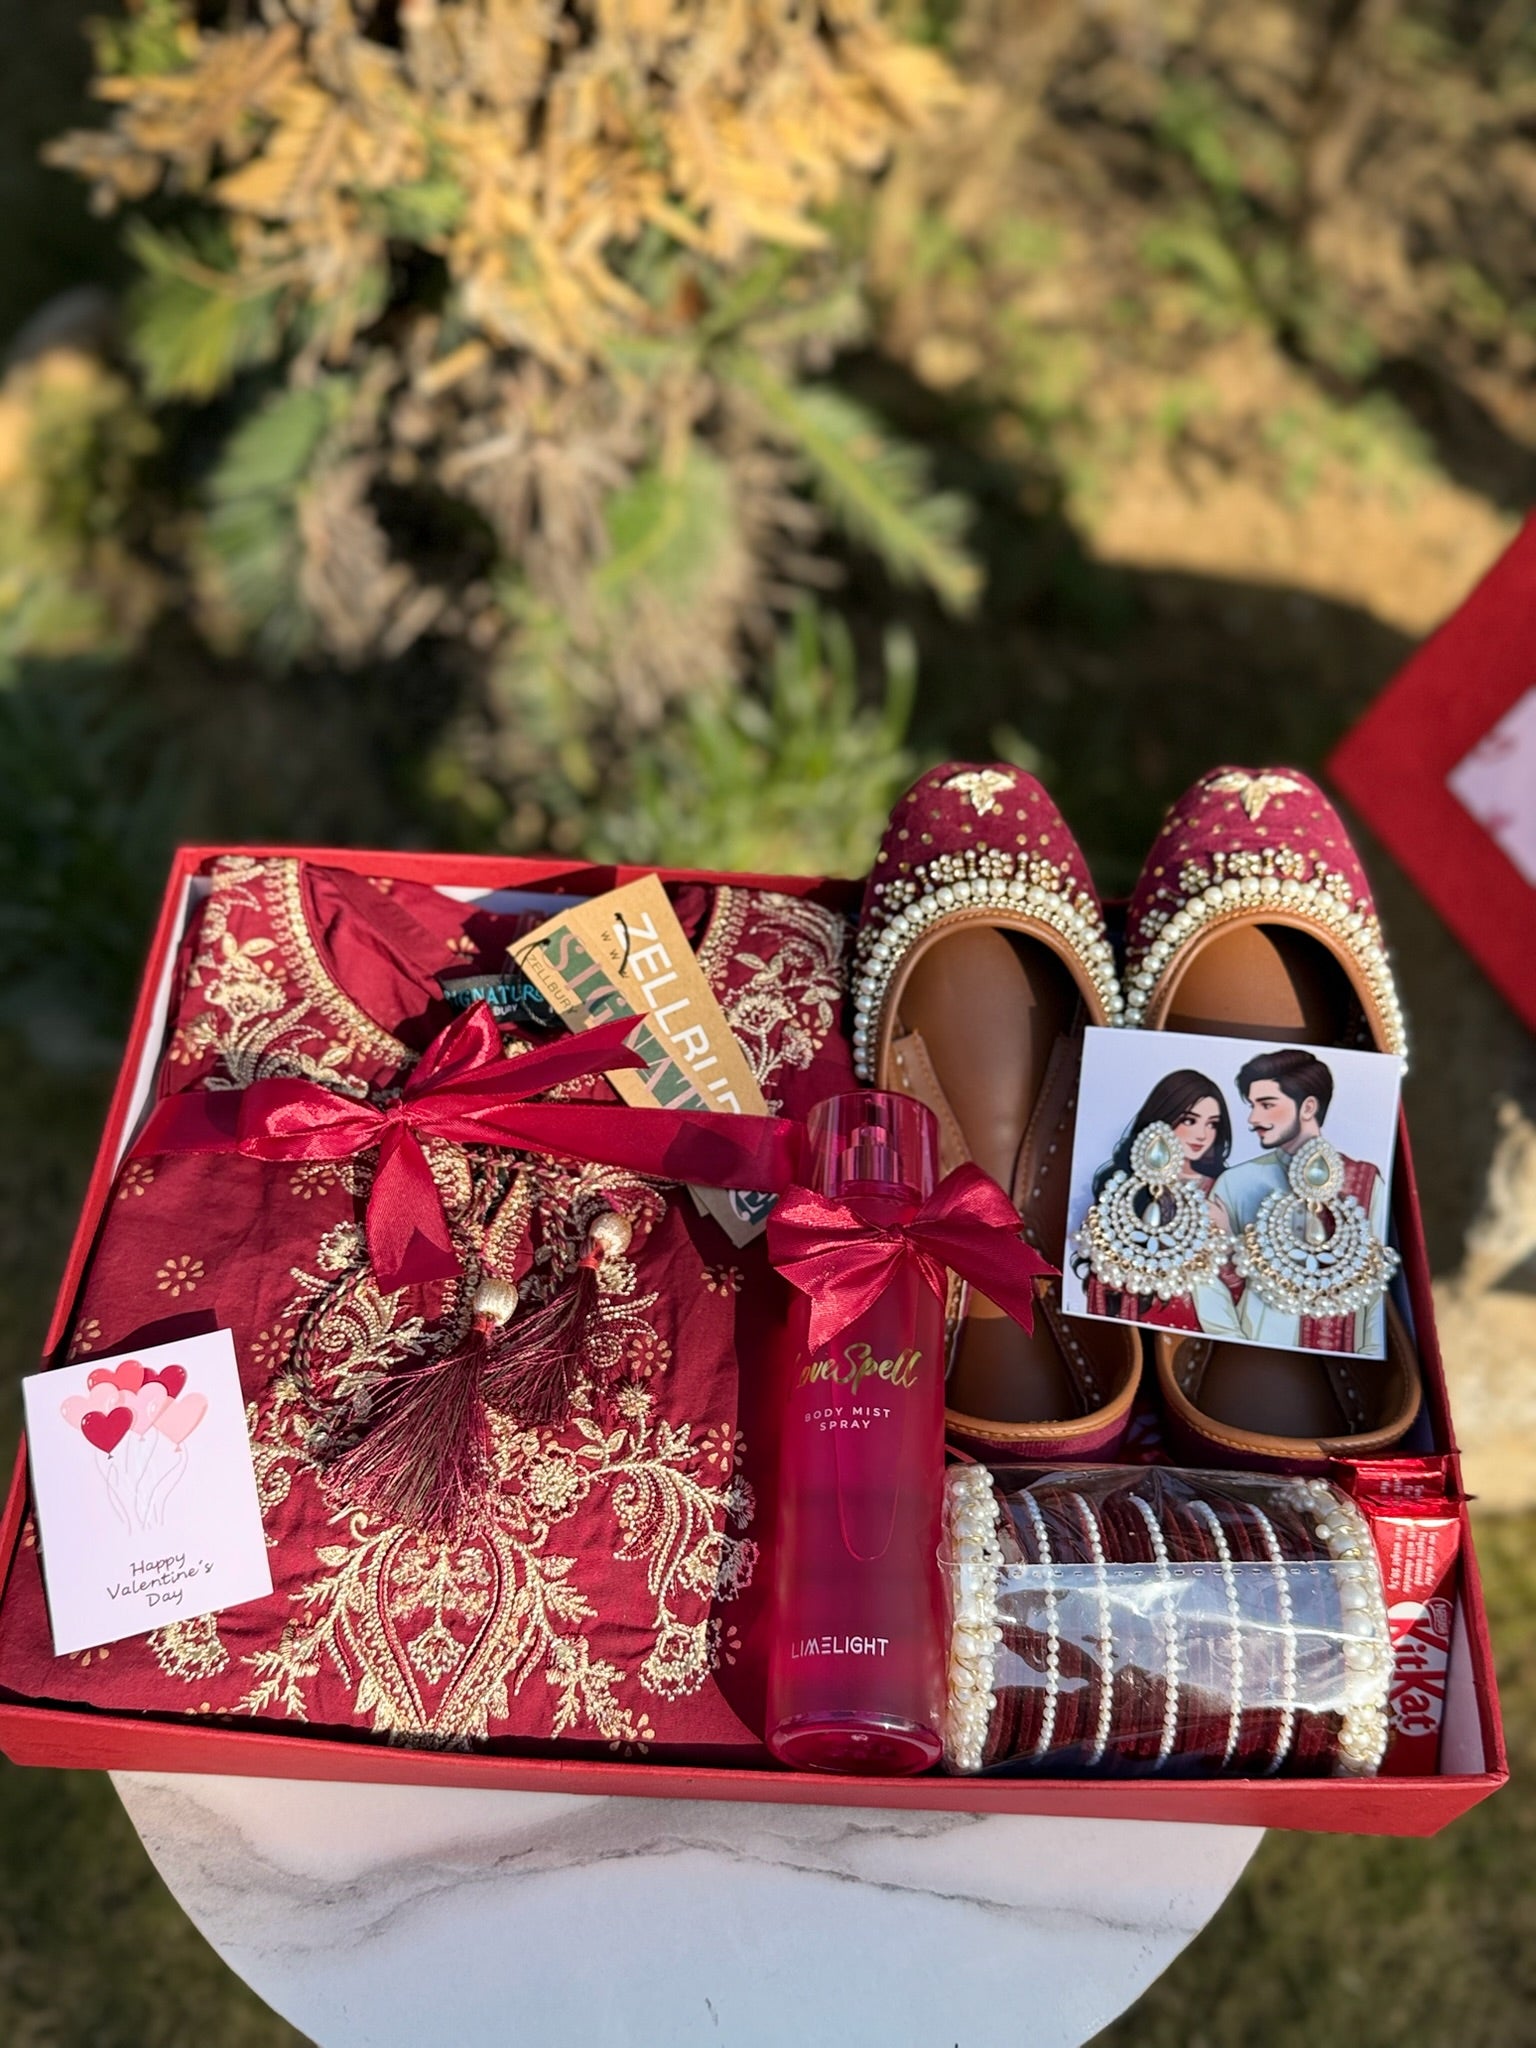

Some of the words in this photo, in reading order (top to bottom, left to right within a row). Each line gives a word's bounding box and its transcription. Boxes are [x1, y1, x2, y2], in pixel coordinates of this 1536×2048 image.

[526, 954, 578, 1014] ZELLBURY
[840, 1342, 922, 1395] Spell
[805, 1407, 843, 1422] BODY
[852, 1406, 891, 1418] MIST
[819, 1419, 871, 1431] SPRAY
[129, 1553, 185, 1576] Happy
[106, 1559, 215, 1600] Valentine's
[146, 1588, 184, 1607] Day
[791, 1636, 889, 1659] LIMELIGHT
[1389, 1618, 1449, 1730] KitKat
